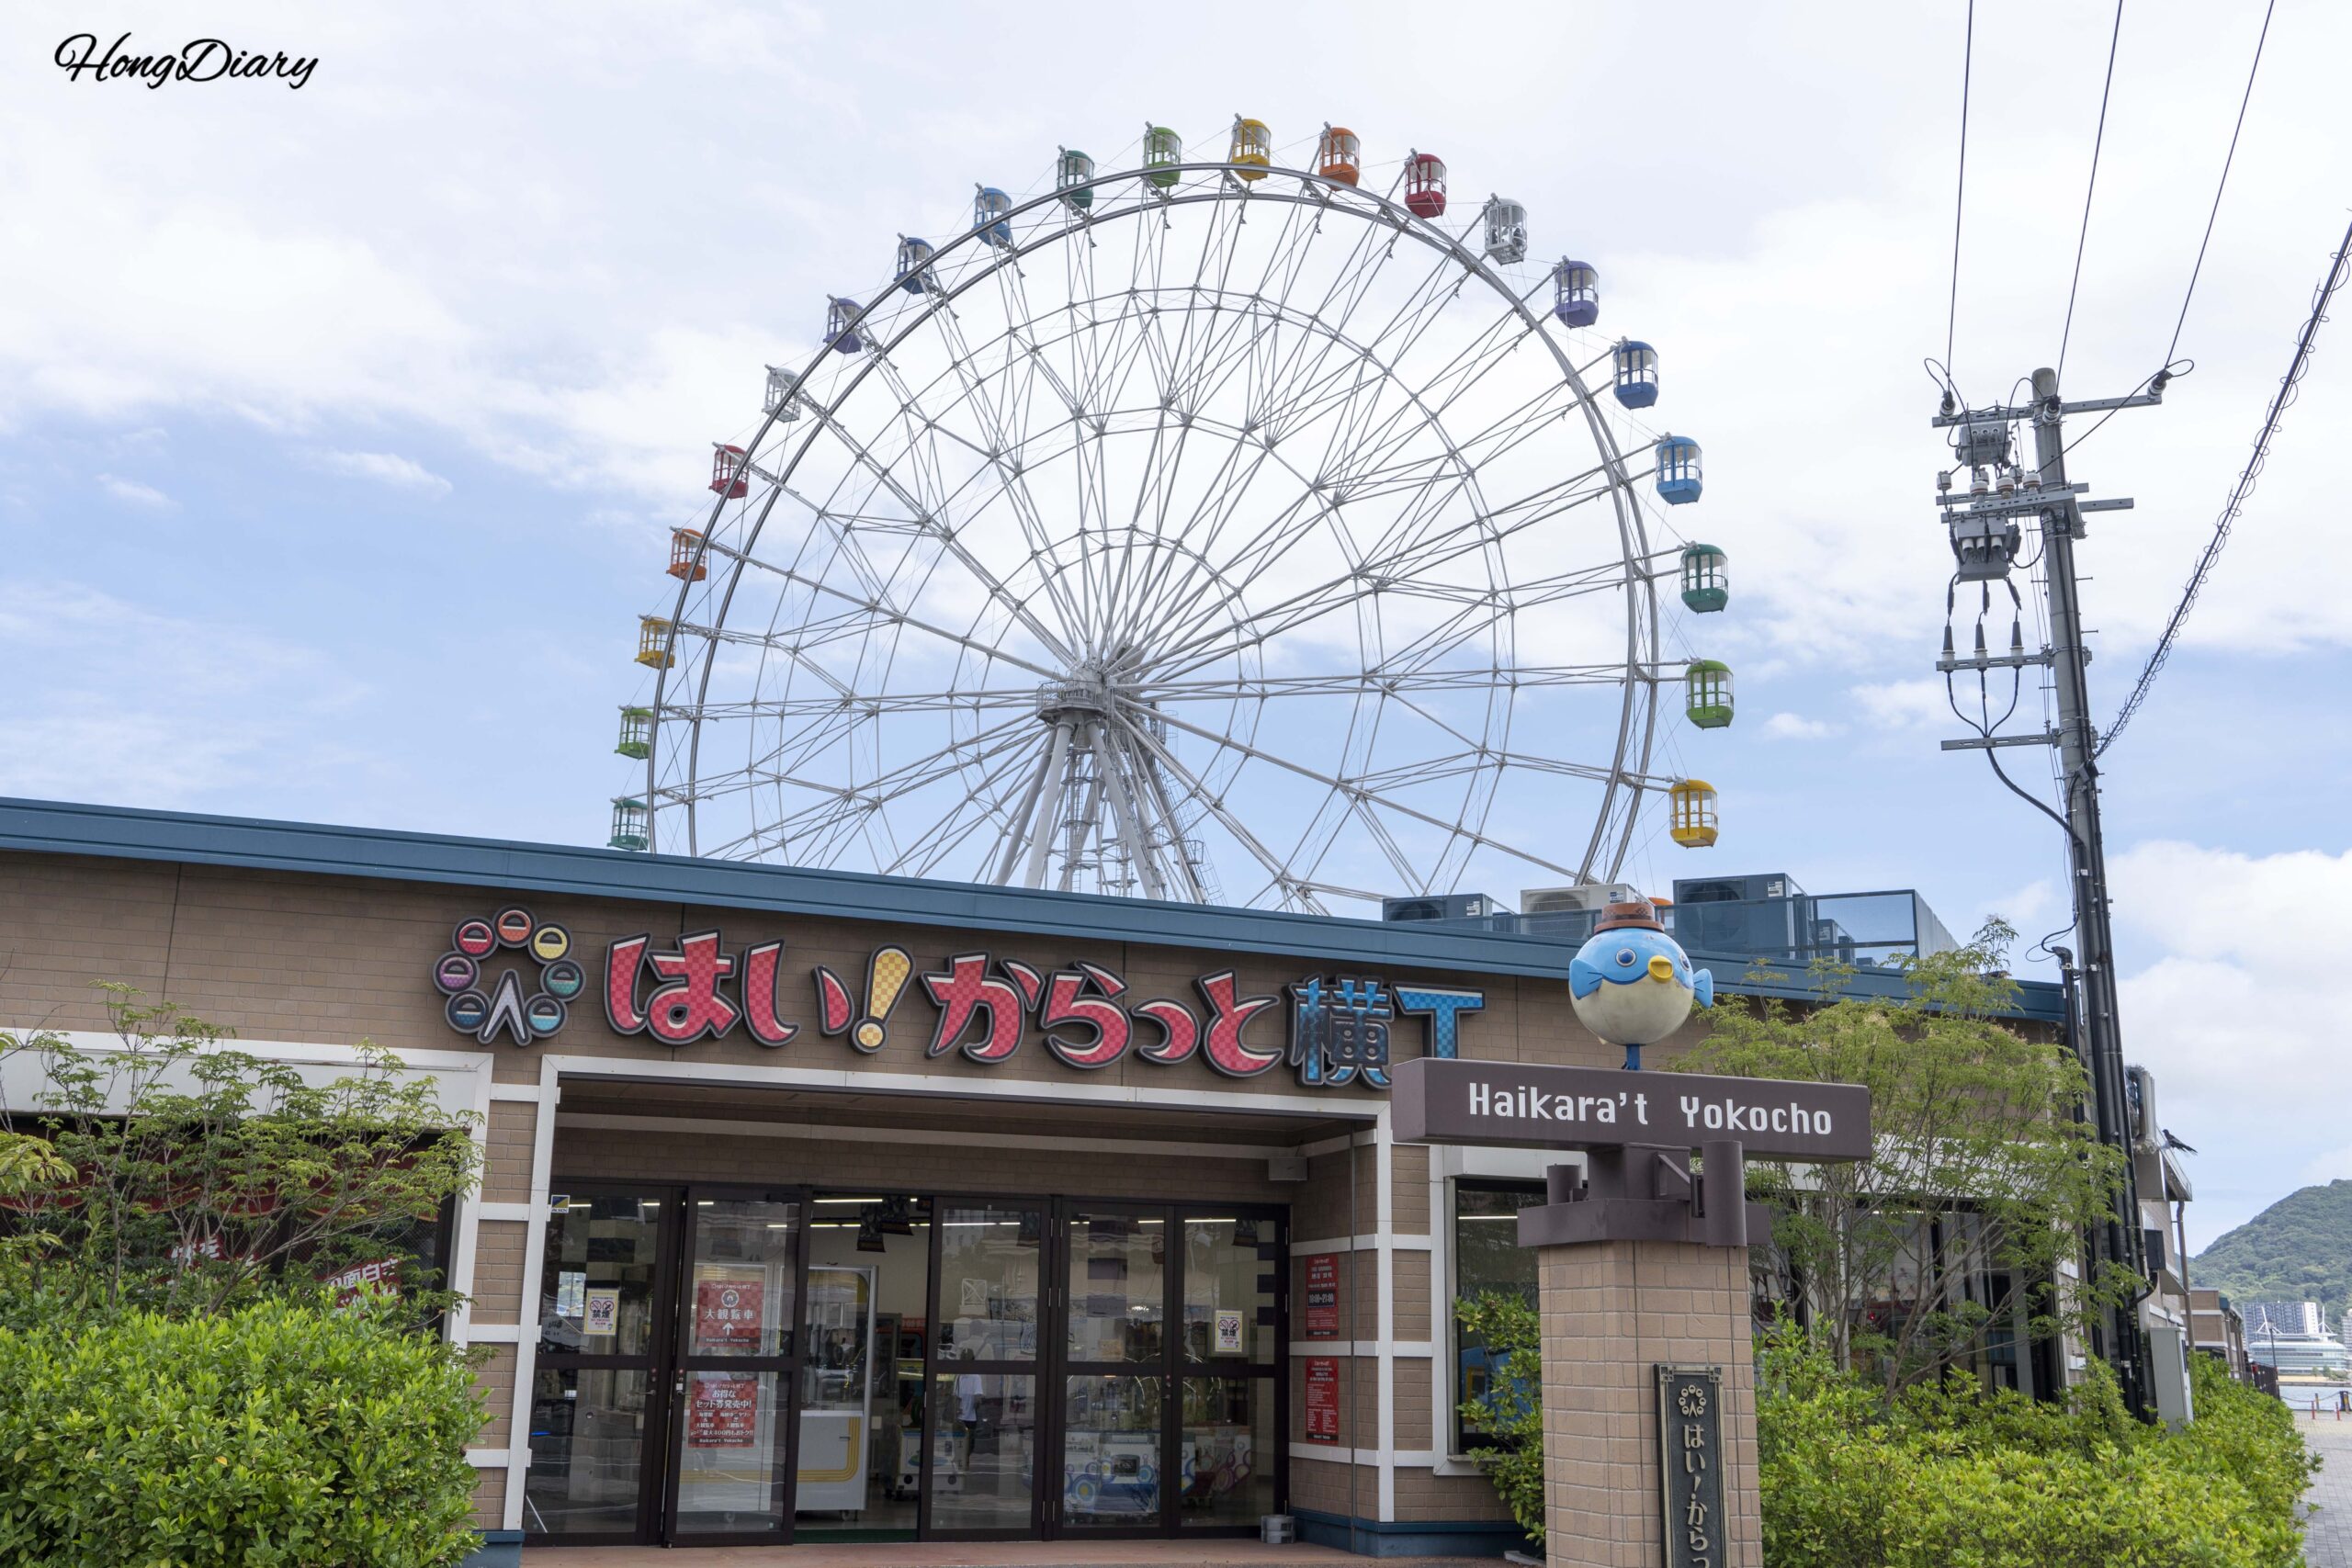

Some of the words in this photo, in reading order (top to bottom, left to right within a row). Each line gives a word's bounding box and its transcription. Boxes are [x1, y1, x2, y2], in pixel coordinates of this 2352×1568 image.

[1469, 1082, 1648, 1125] Haikara't
[1680, 1096, 1832, 1134] Yokocho
[705, 1308, 753, 1320] 大観覧車
